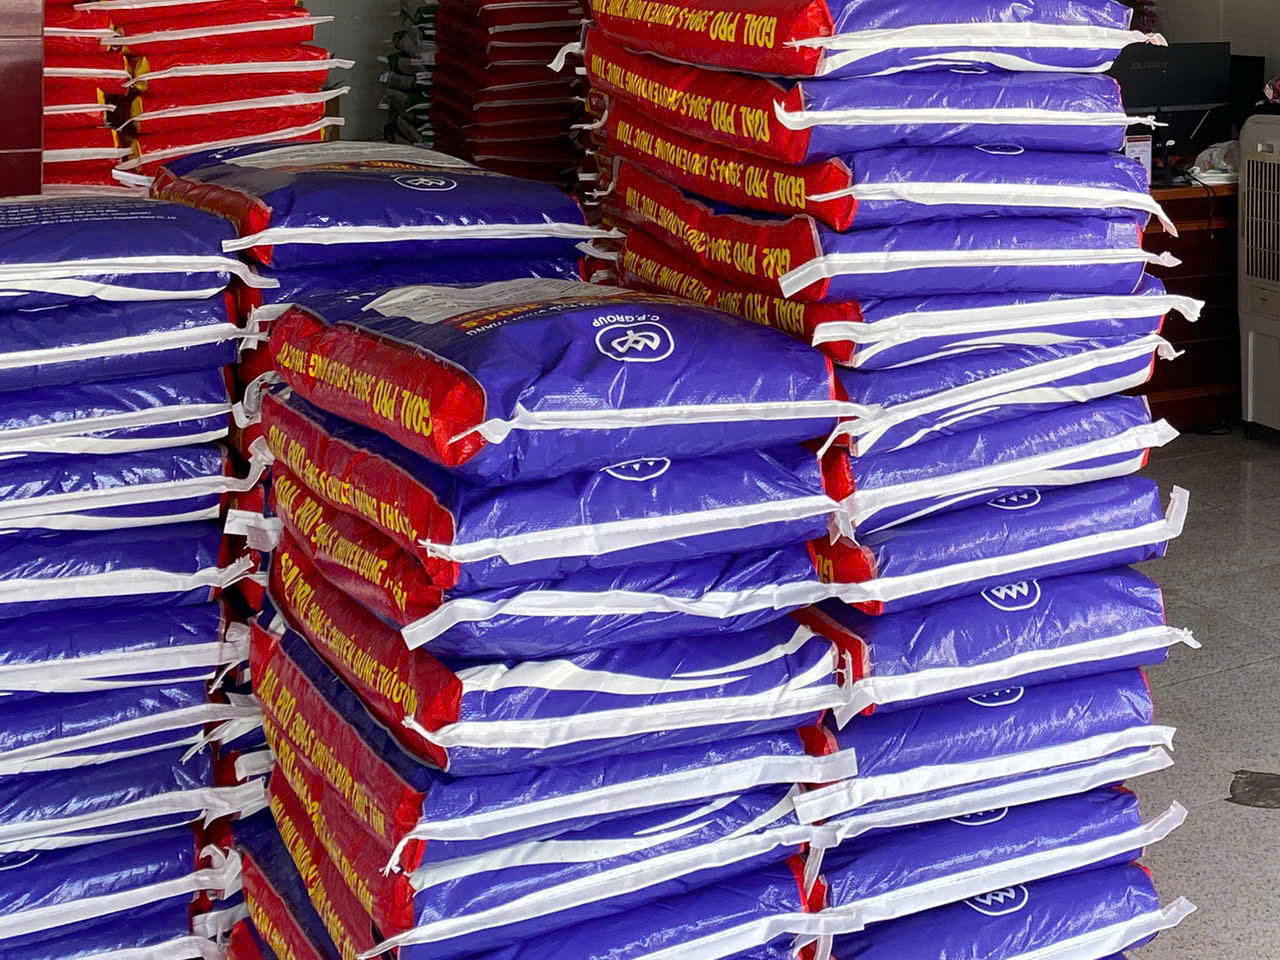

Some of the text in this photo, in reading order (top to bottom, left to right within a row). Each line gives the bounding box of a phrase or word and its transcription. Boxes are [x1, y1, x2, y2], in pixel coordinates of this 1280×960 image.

[676, 6, 710, 33] 3904-S
[710, 11, 742, 43] PRO
[743, 14, 777, 48] GOAL
[711, 101, 737, 135] PRO
[744, 166, 769, 199] PRO
[773, 172, 806, 209] GOAL
[733, 242, 756, 275] PRO
[372, 379, 400, 421] PRO
[401, 389, 433, 437] GOAL
[287, 440, 306, 479] PRO
[294, 496, 324, 536] PRO
[273, 686, 296, 731] PRO
